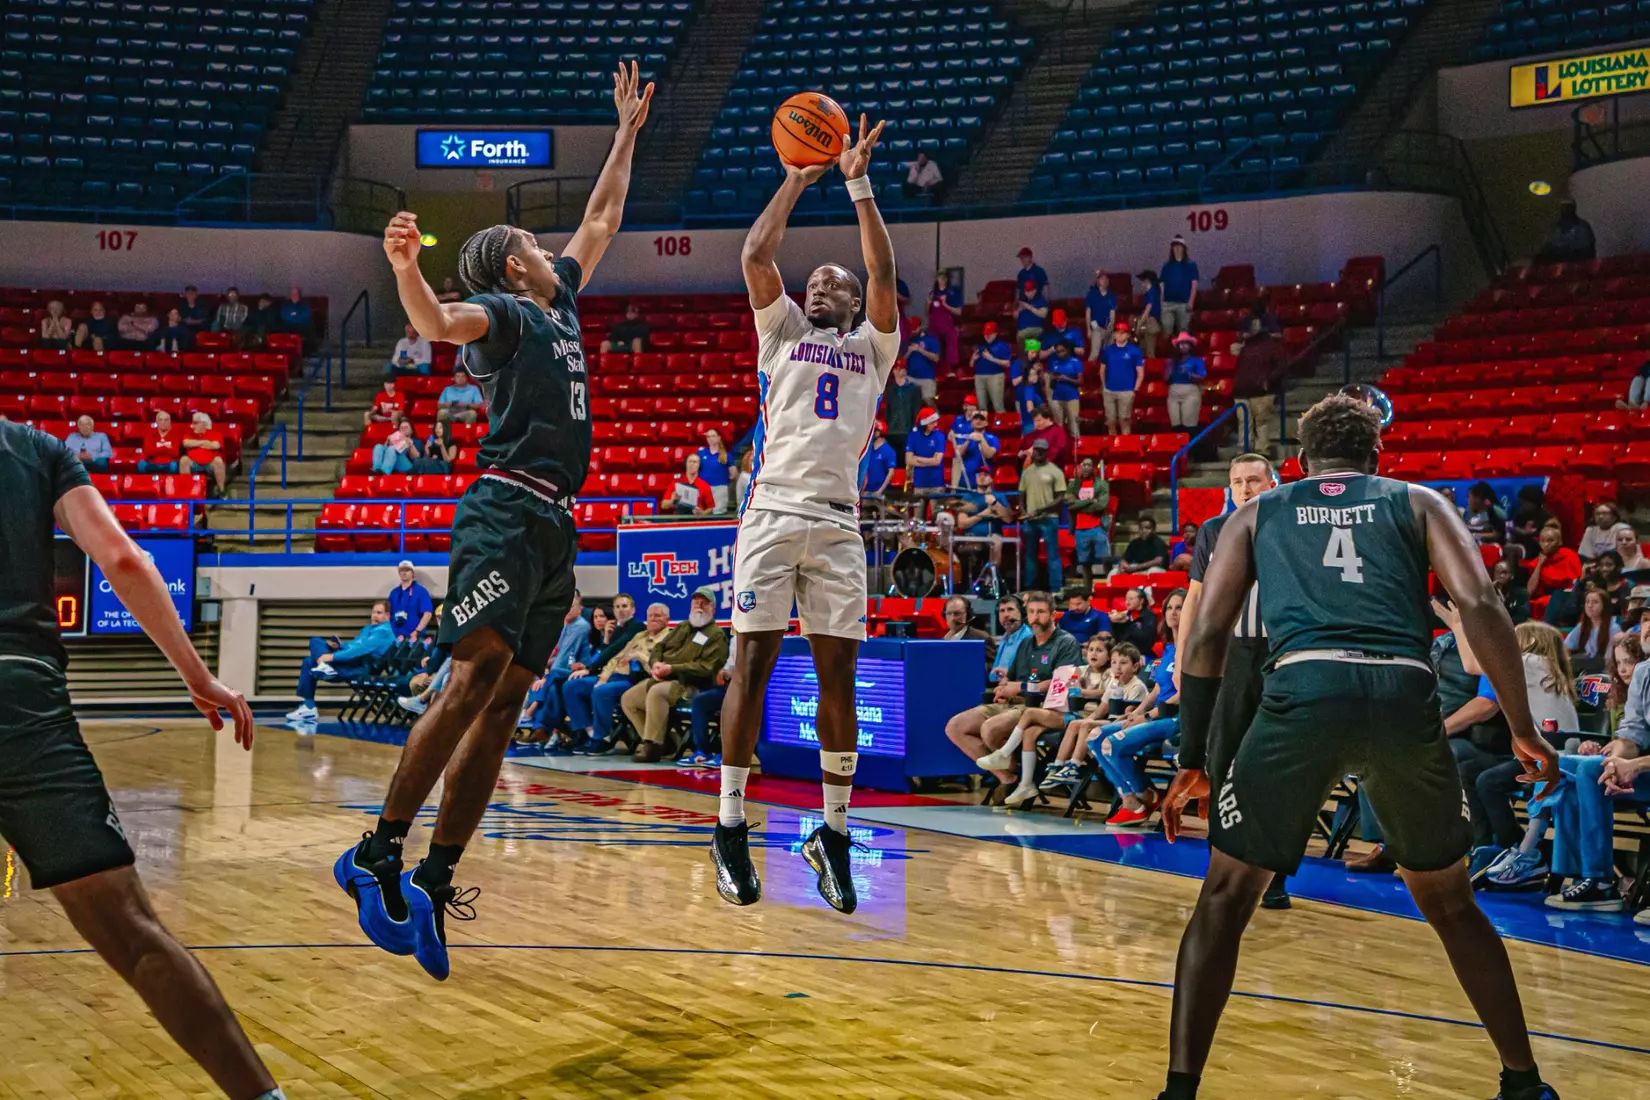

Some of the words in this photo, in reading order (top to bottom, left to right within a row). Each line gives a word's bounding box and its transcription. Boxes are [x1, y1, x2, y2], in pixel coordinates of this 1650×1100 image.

[1559, 52, 1649, 79] LOUISIANA
[1572, 70, 1649, 96] LOTTERY
[788, 110, 833, 149] Wilson
[1186, 209, 1229, 232] 109
[95, 230, 138, 251] 107
[653, 236, 691, 257] 108
[570, 381, 586, 420] 13
[814, 371, 839, 420] 8
[1296, 504, 1376, 526] BURNETT
[1323, 526, 1364, 584] 4
[57, 596, 76, 627] 0
[451, 570, 510, 627] BEARS
